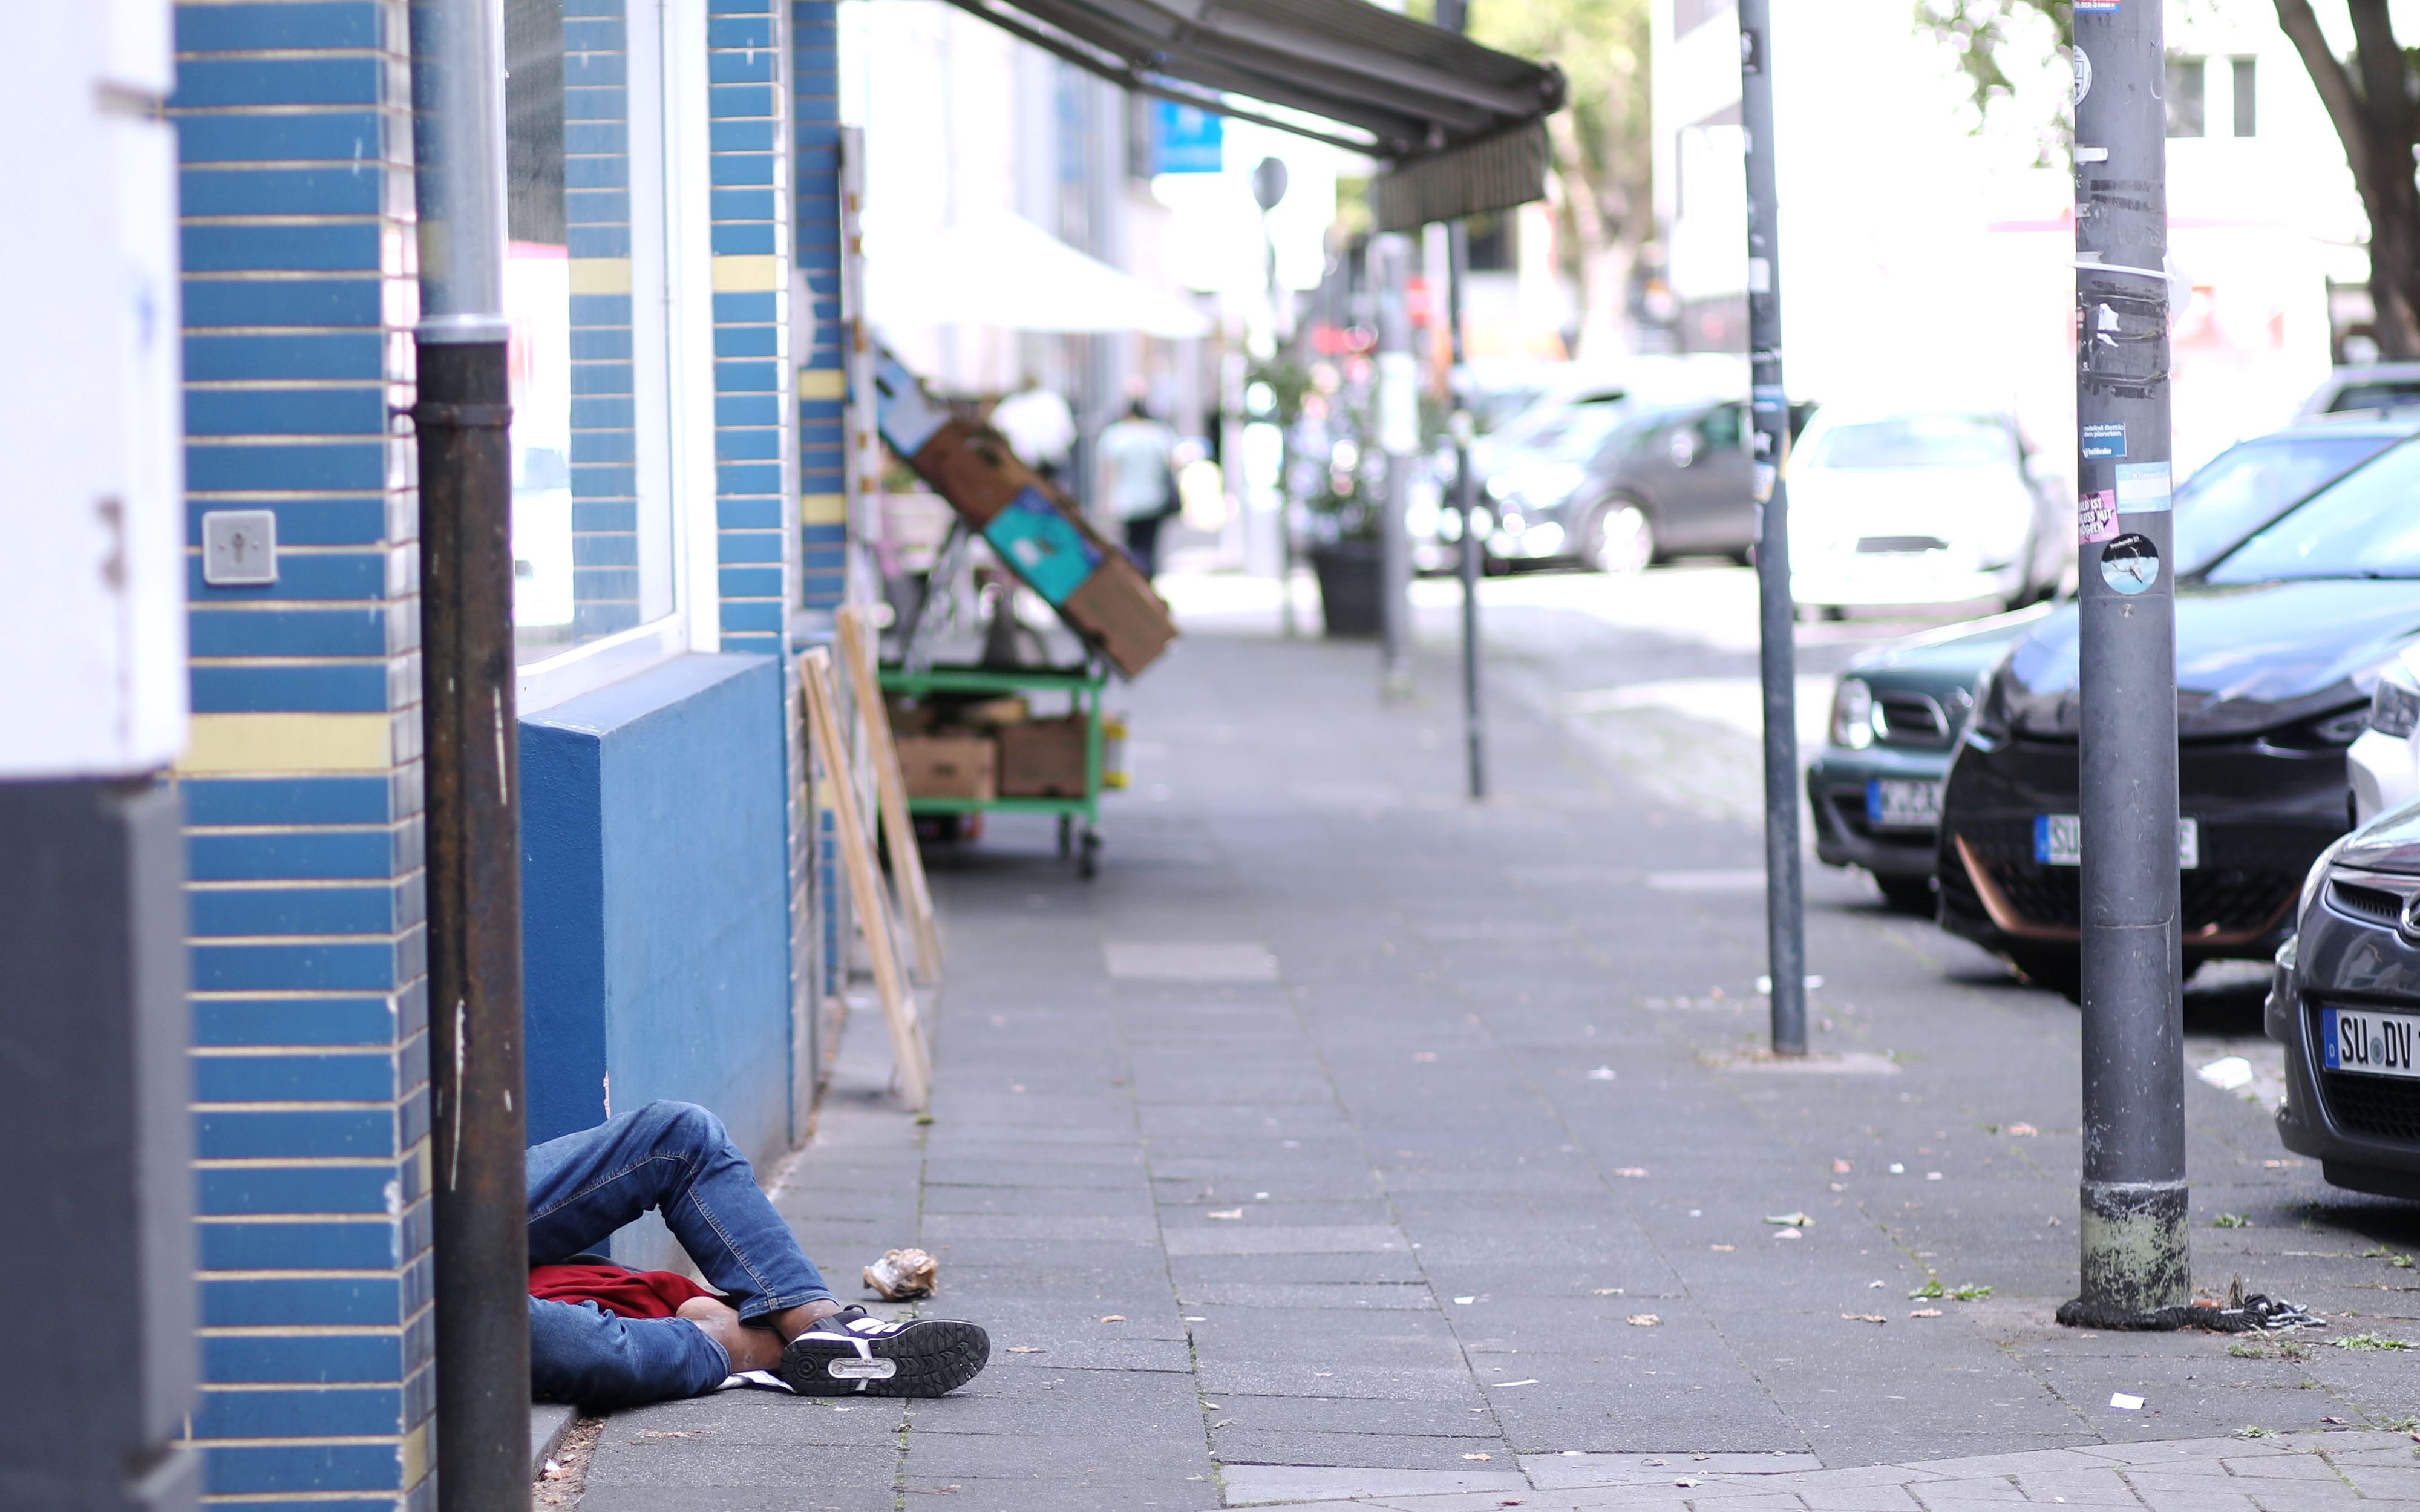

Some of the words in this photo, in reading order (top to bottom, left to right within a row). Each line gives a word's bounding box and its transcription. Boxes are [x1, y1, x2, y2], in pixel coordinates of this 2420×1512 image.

[2052, 823, 2079, 856] SU
[2341, 1016, 2369, 1064] SU
[2382, 1021, 2412, 1069] DV
